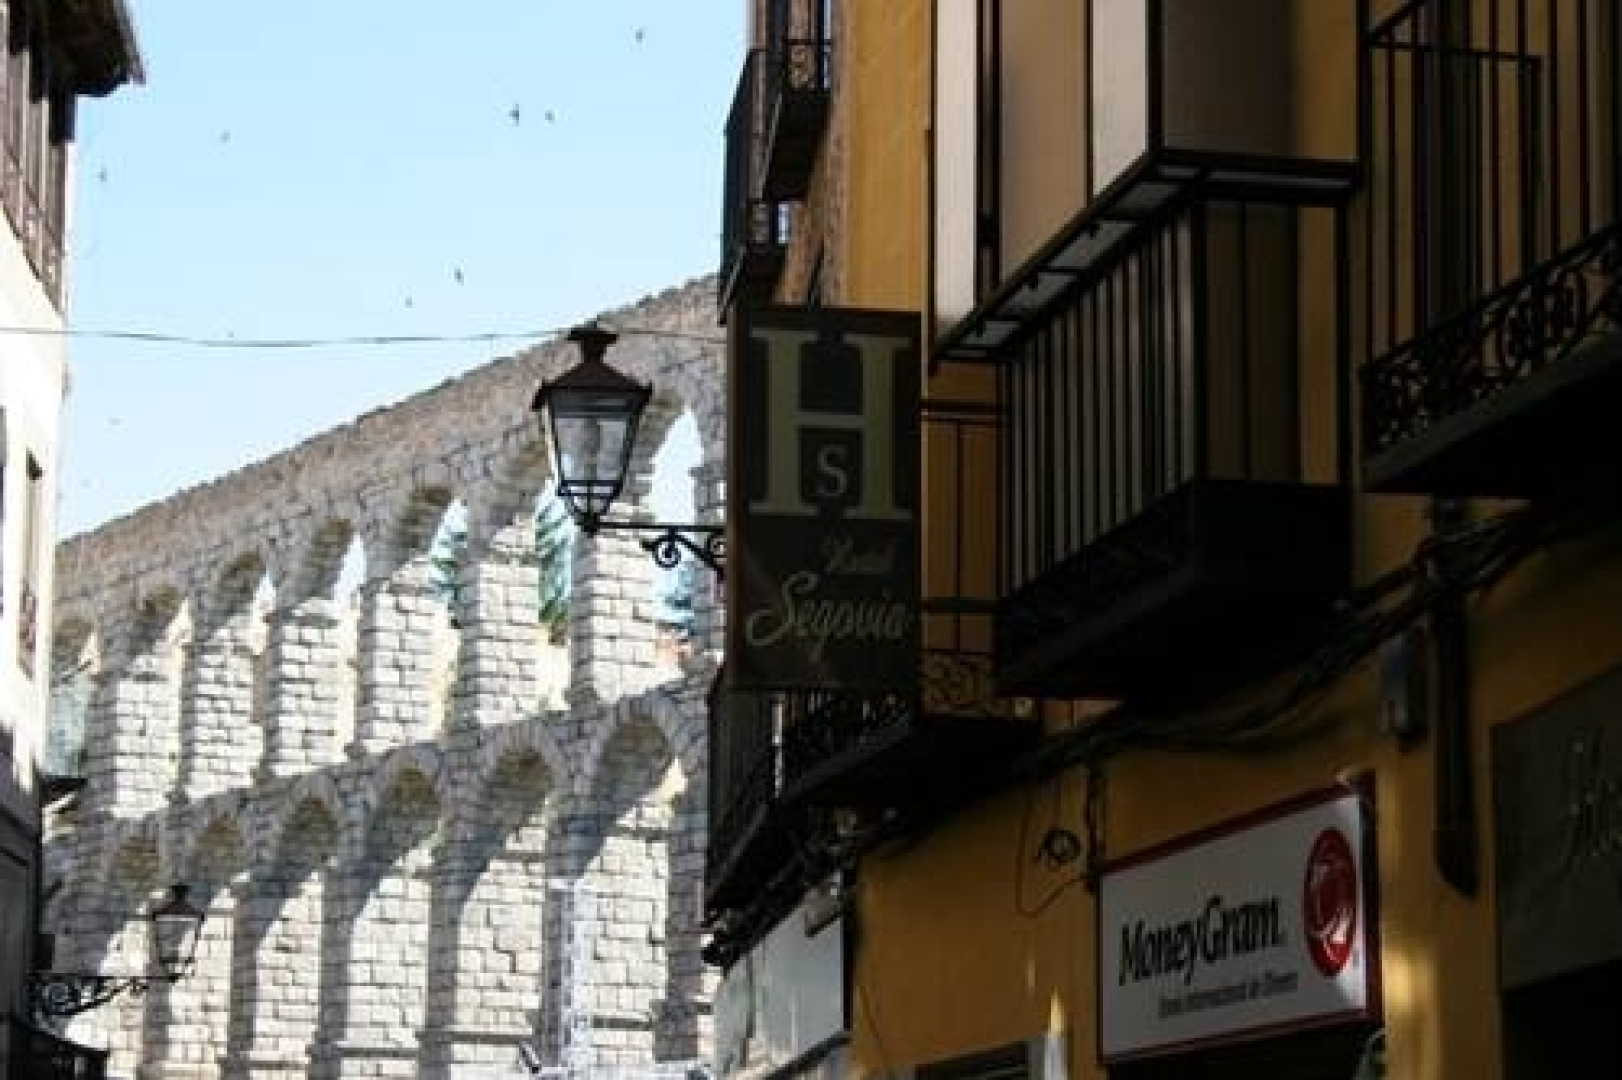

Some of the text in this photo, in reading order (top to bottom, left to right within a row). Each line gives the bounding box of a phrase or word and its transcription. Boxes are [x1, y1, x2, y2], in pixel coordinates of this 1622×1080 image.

[749, 329, 912, 519] H
[817, 443, 848, 498] S
[745, 571, 907, 662] Segovia
[1119, 896, 1282, 985] MoneyGram
